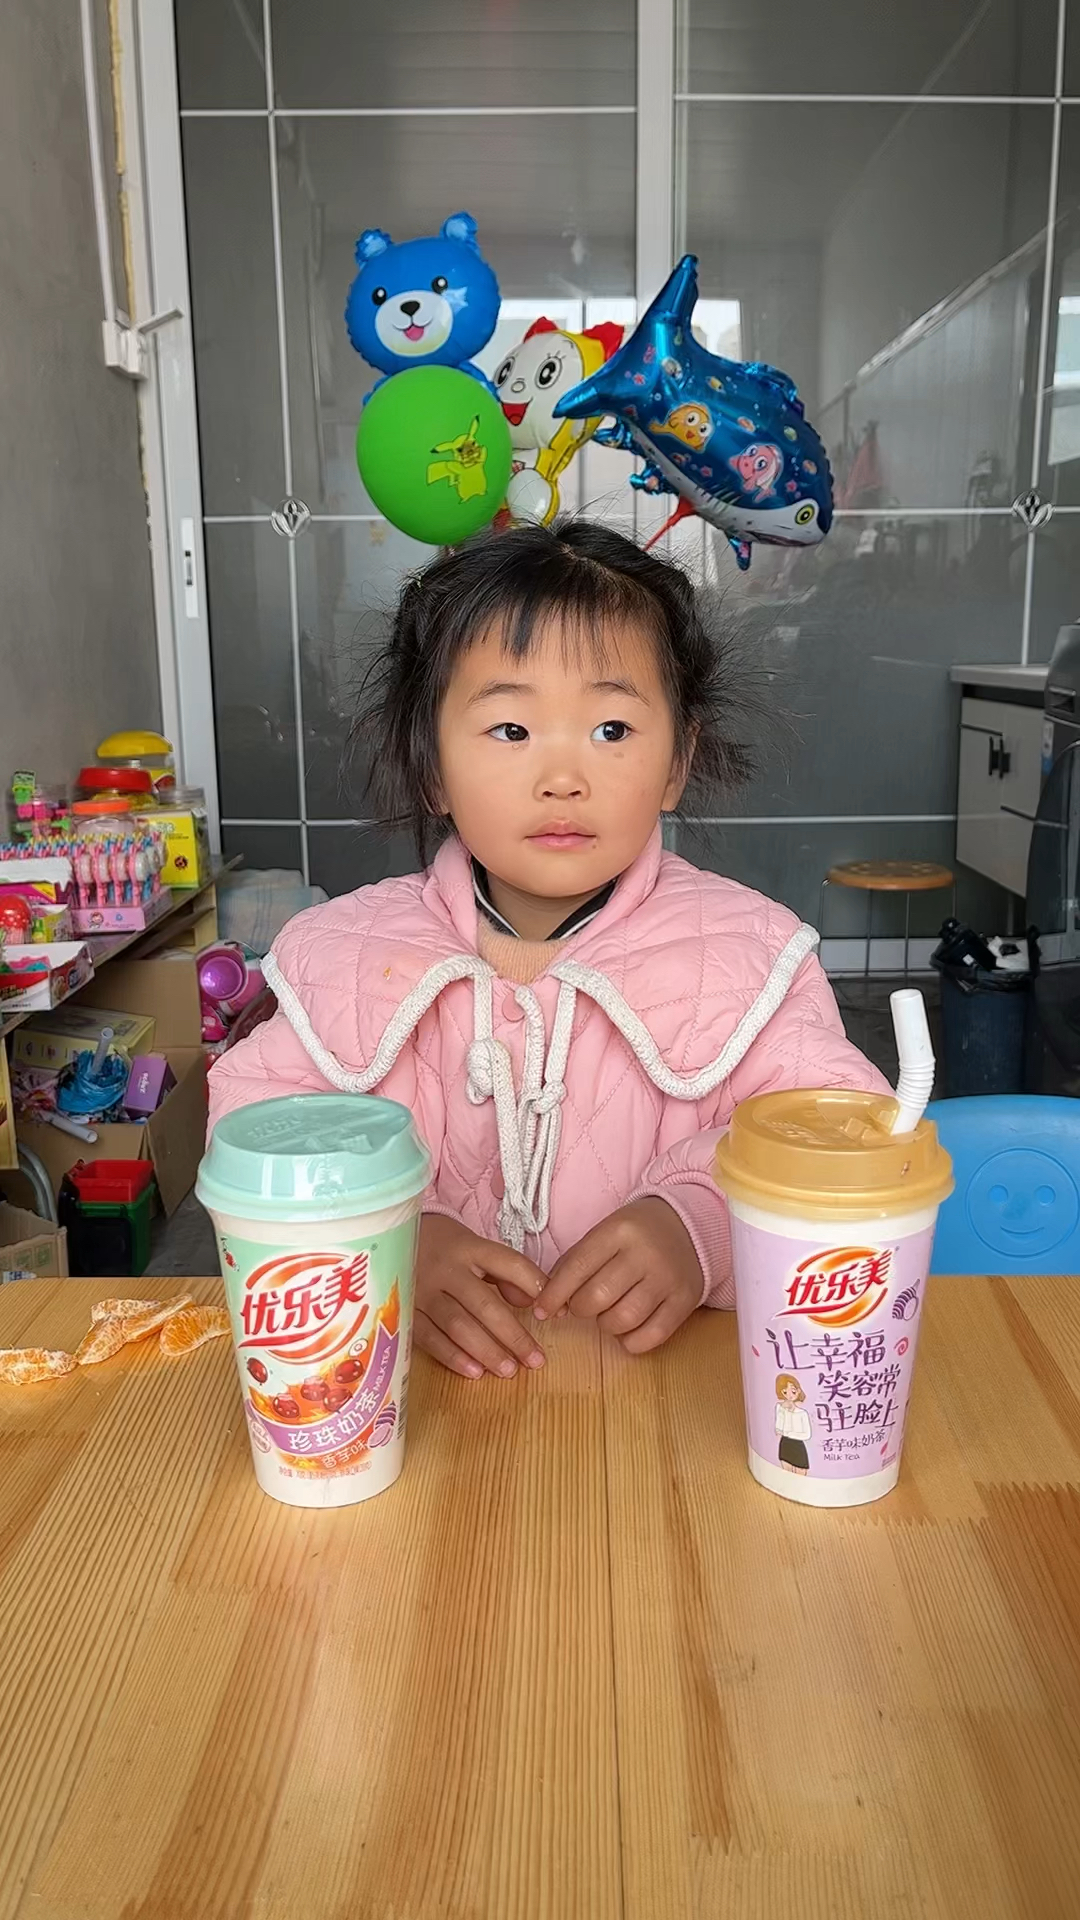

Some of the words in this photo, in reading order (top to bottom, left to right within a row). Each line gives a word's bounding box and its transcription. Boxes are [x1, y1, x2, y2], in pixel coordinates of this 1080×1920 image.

[239, 1251, 369, 1345] 优乐美
[780, 1249, 893, 1314] 优乐美
[765, 1328, 887, 1371] 让幸福
[817, 1363, 901, 1402] 笑容常
[288, 1387, 380, 1452] 珍珠奶茶
[815, 1399, 899, 1433] 驻脸上
[322, 1438, 368, 1469] 香芋味
[823, 1428, 886, 1452] 香芋味奶茶
